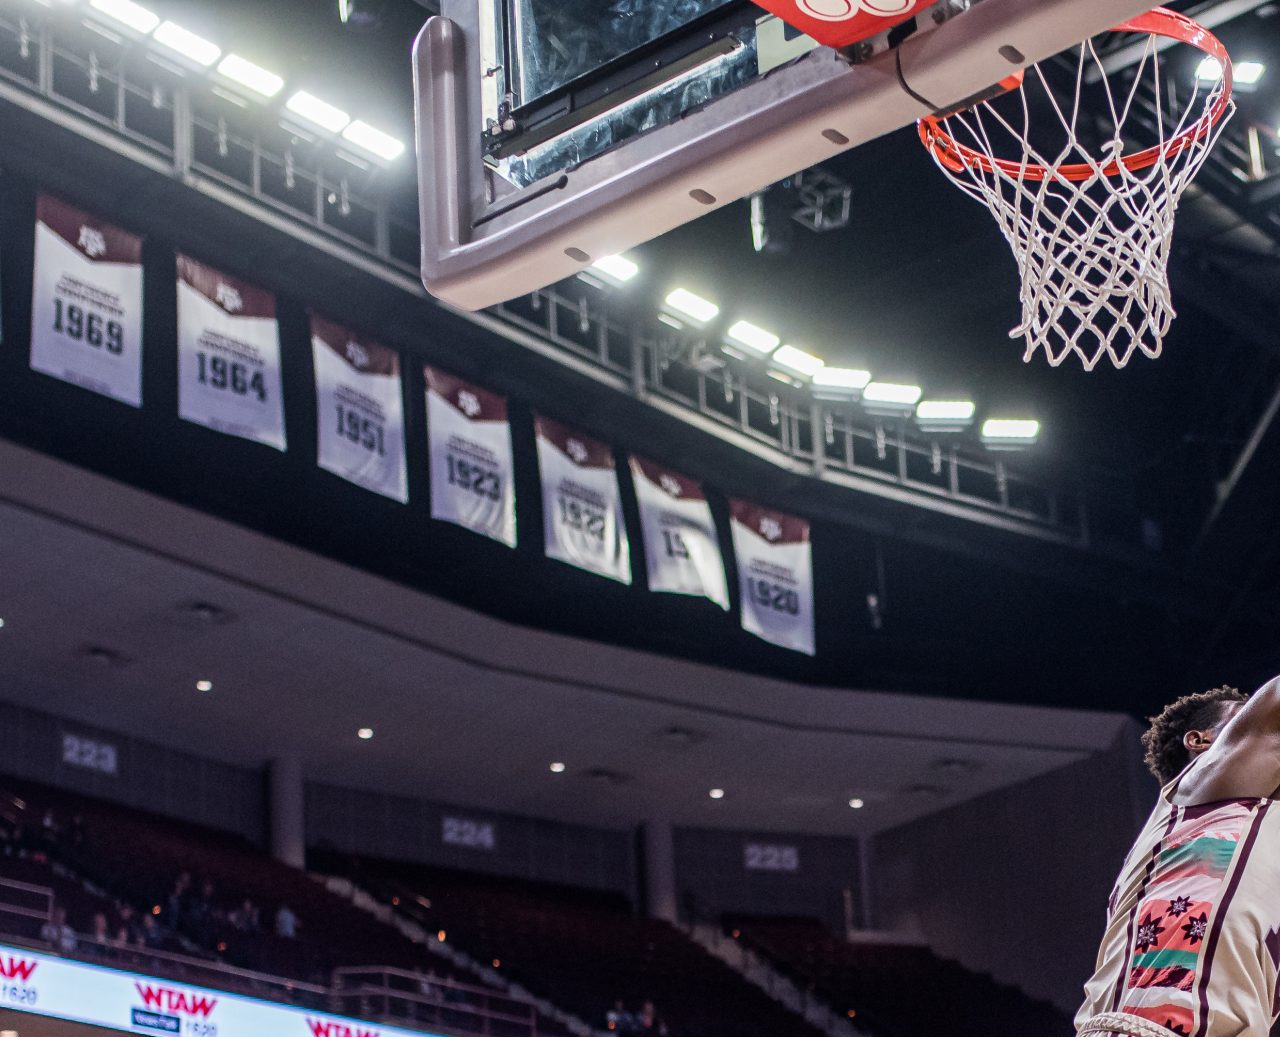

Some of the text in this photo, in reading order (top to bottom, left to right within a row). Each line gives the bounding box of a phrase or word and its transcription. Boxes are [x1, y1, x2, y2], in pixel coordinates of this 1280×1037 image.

[52, 297, 123, 356] 1969
[196, 352, 267, 402] 1964
[336, 404, 385, 457] 1951
[447, 453, 500, 501] 1923
[748, 577, 800, 616] 1920
[63, 736, 117, 774] 223
[135, 983, 217, 1017] WTAW
